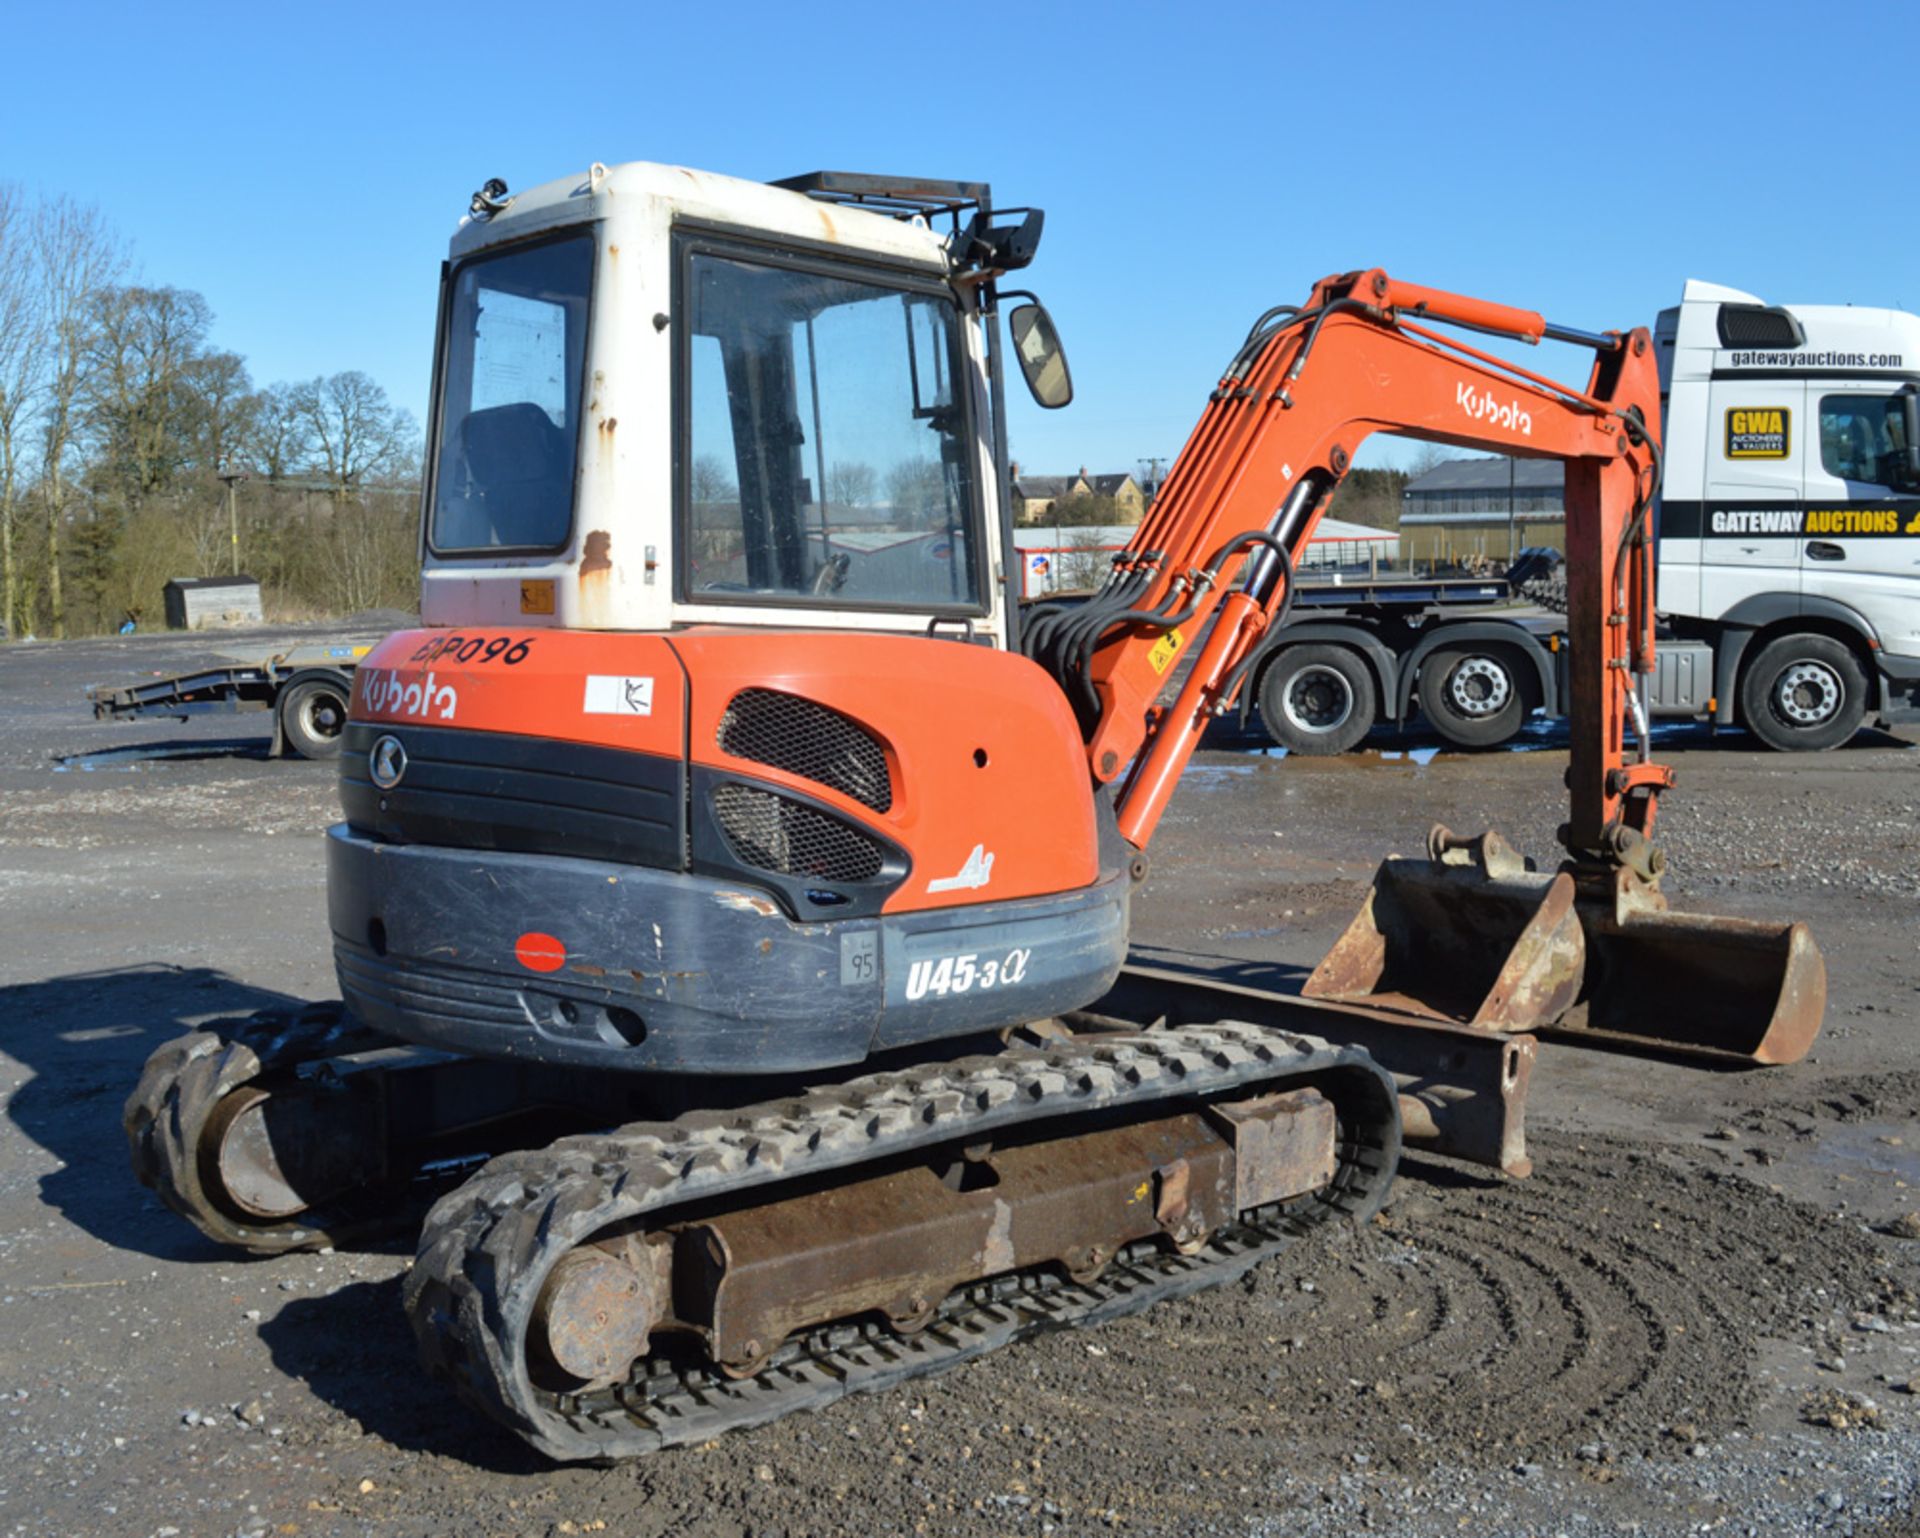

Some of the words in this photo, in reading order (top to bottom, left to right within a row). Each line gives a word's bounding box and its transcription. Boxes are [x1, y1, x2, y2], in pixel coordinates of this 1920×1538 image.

[1731, 351, 1902, 367] gatewayauctions.com
[1456, 381, 1532, 436] Kubota
[1732, 412, 1783, 434] GWA
[1711, 511, 1803, 533] GATEWAY
[1805, 511, 1898, 533] AUCTIONS
[362, 669, 458, 719] Kubota
[851, 953, 873, 980] 95
